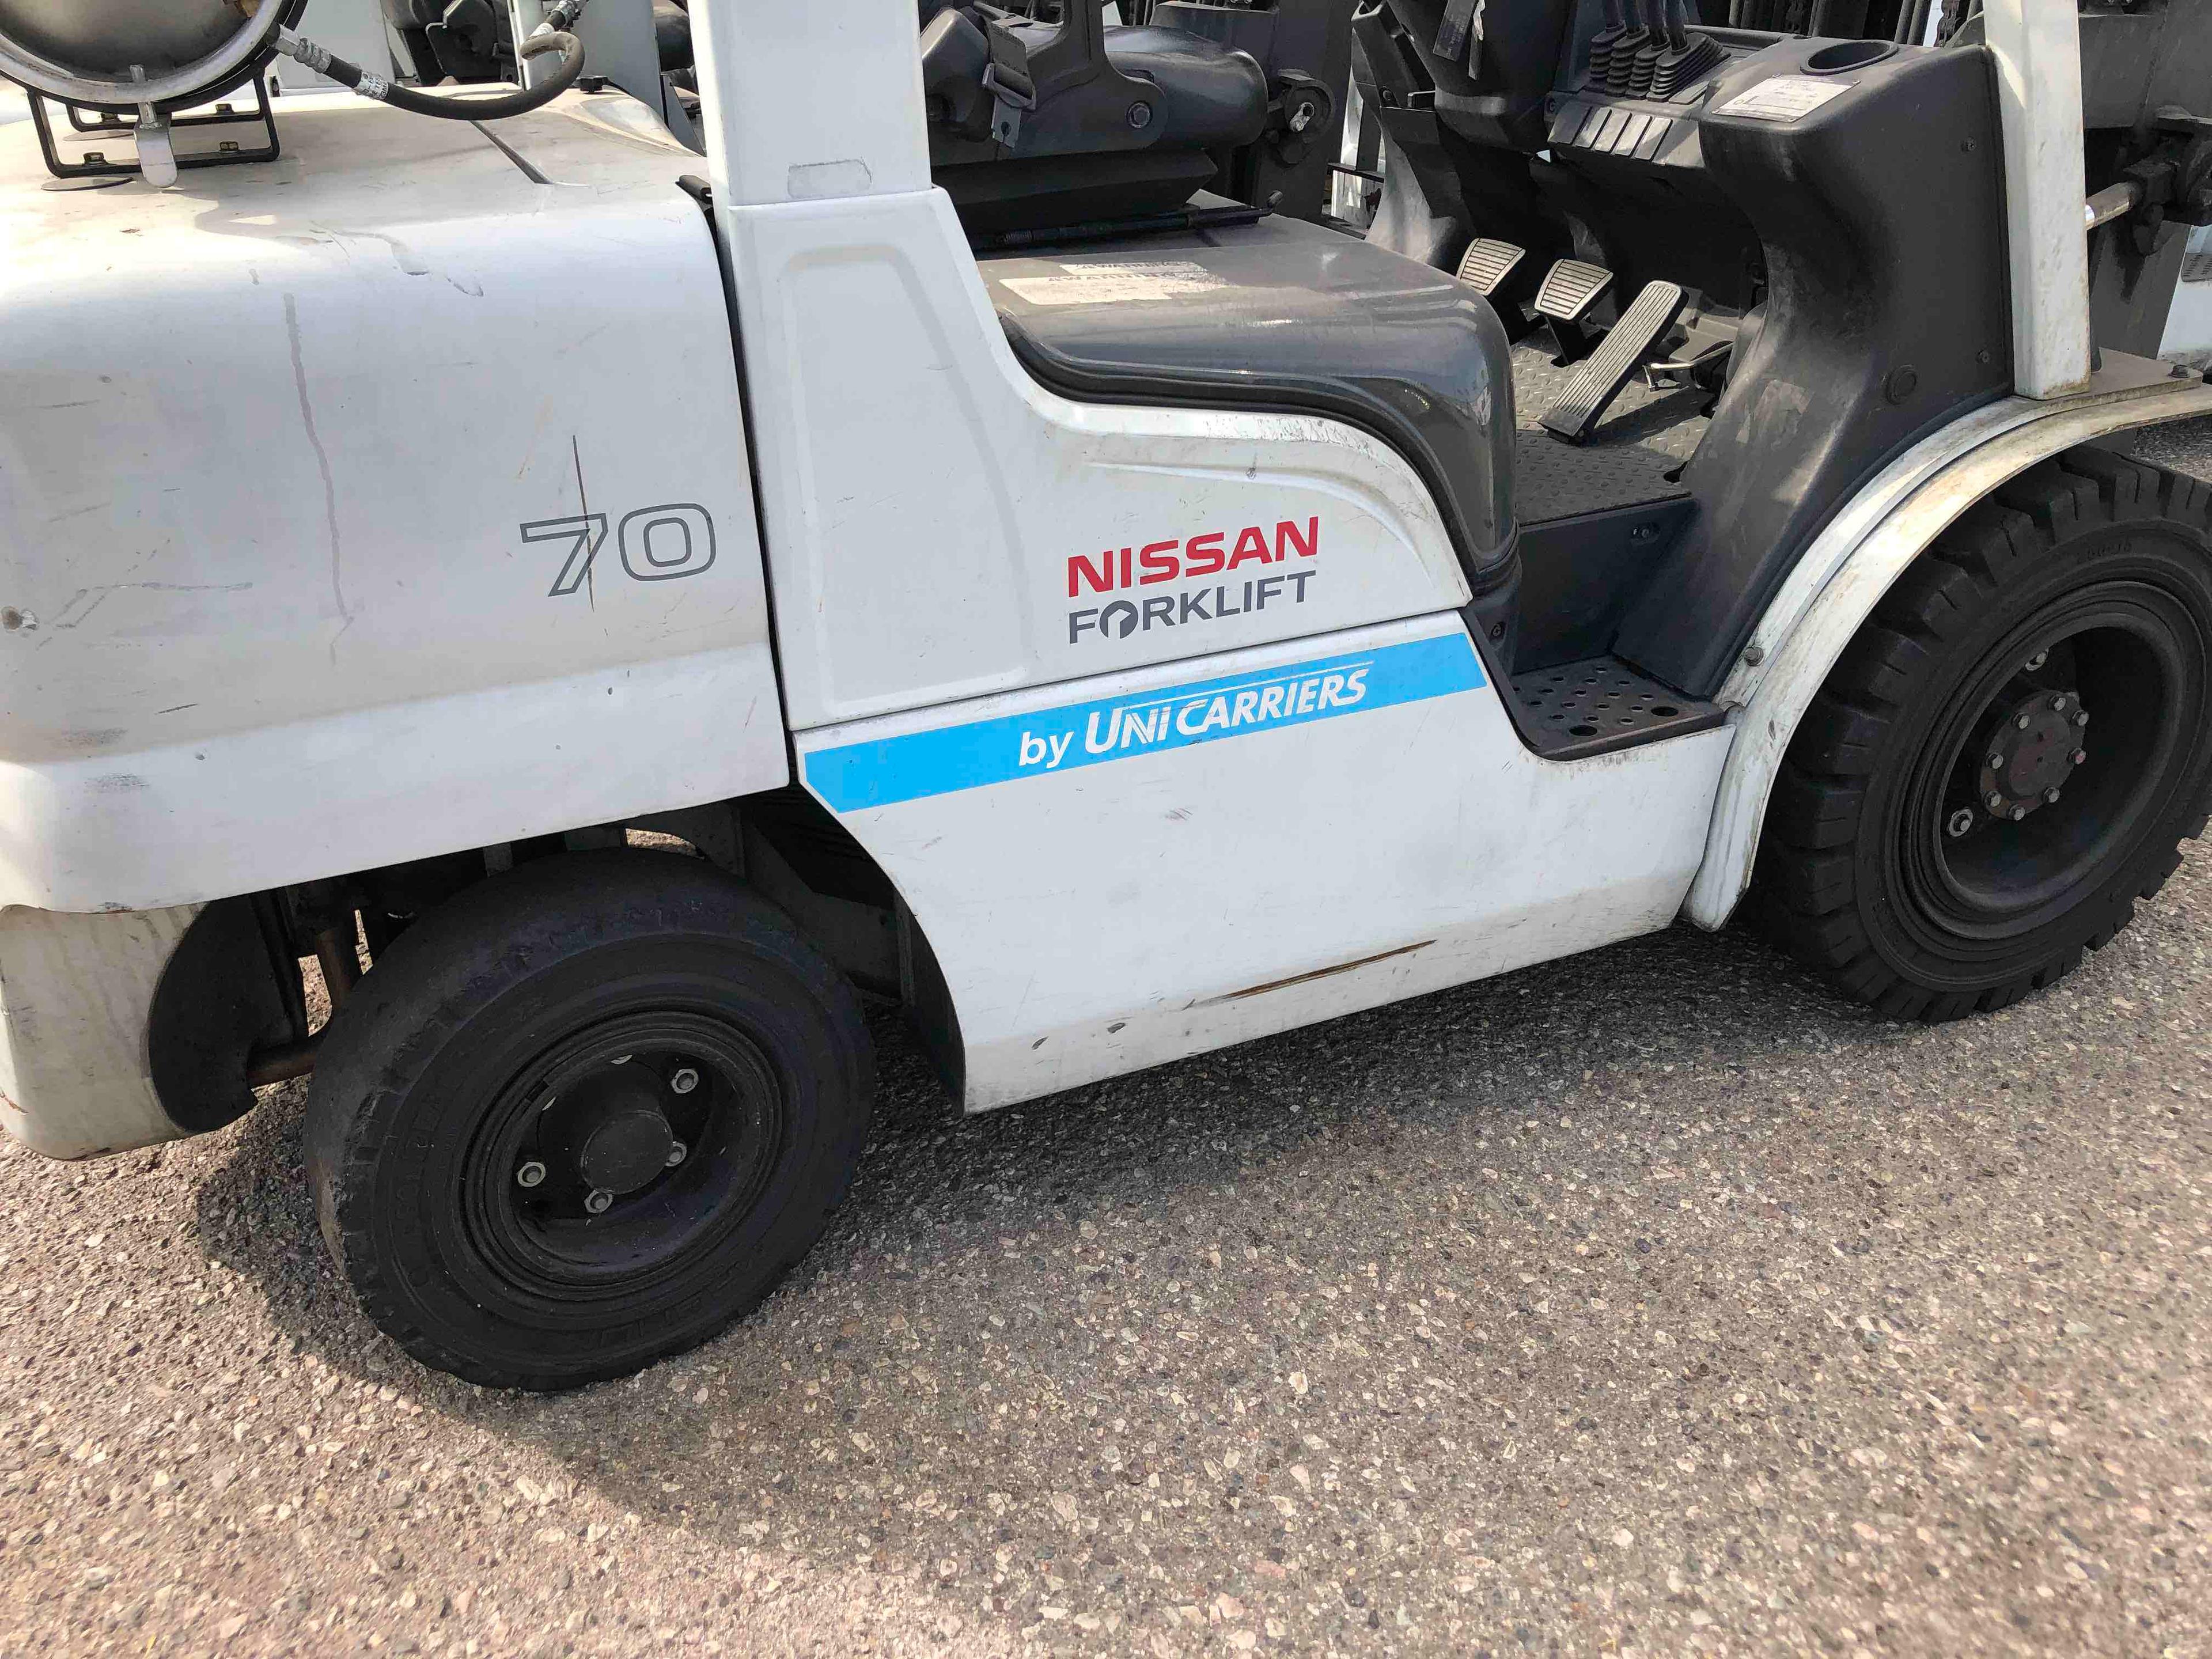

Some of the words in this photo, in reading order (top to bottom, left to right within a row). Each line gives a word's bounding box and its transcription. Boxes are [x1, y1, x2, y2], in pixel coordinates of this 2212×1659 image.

[520, 503, 717, 597] 70
[1068, 516, 1319, 597] NISSAN
[1069, 570, 1316, 645] FORKLIFT
[1018, 730, 1074, 769] by
[1085, 666, 1369, 753] UNICARRIERS
